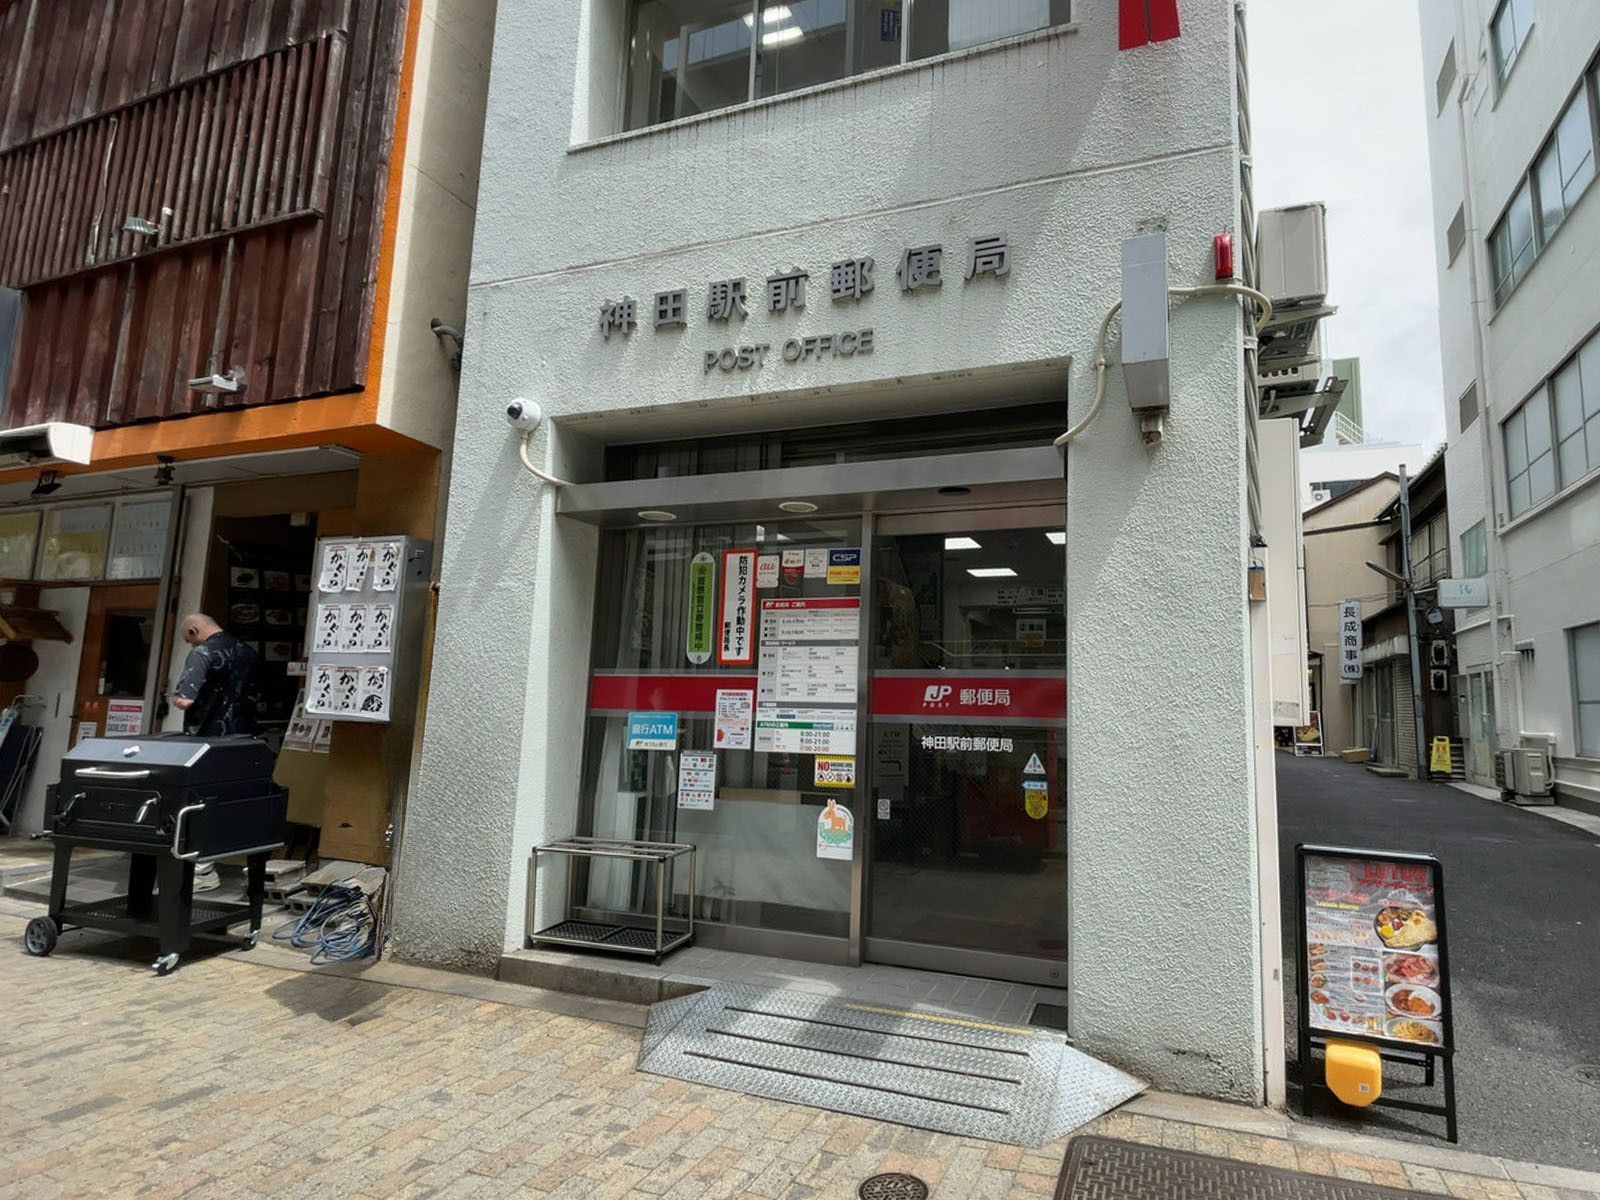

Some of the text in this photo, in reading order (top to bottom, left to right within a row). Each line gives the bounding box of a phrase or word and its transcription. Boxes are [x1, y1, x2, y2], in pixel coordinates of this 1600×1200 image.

[599, 232, 1012, 339] 神田駅前郵便局
[704, 329, 874, 373] POST OFFICE
[735, 555, 749, 657] 防犯カメラ作動中です
[960, 688, 1010, 706] 郵便局
[921, 736, 1013, 752] 神田駅前郵便局
[817, 761, 829, 771] NO
